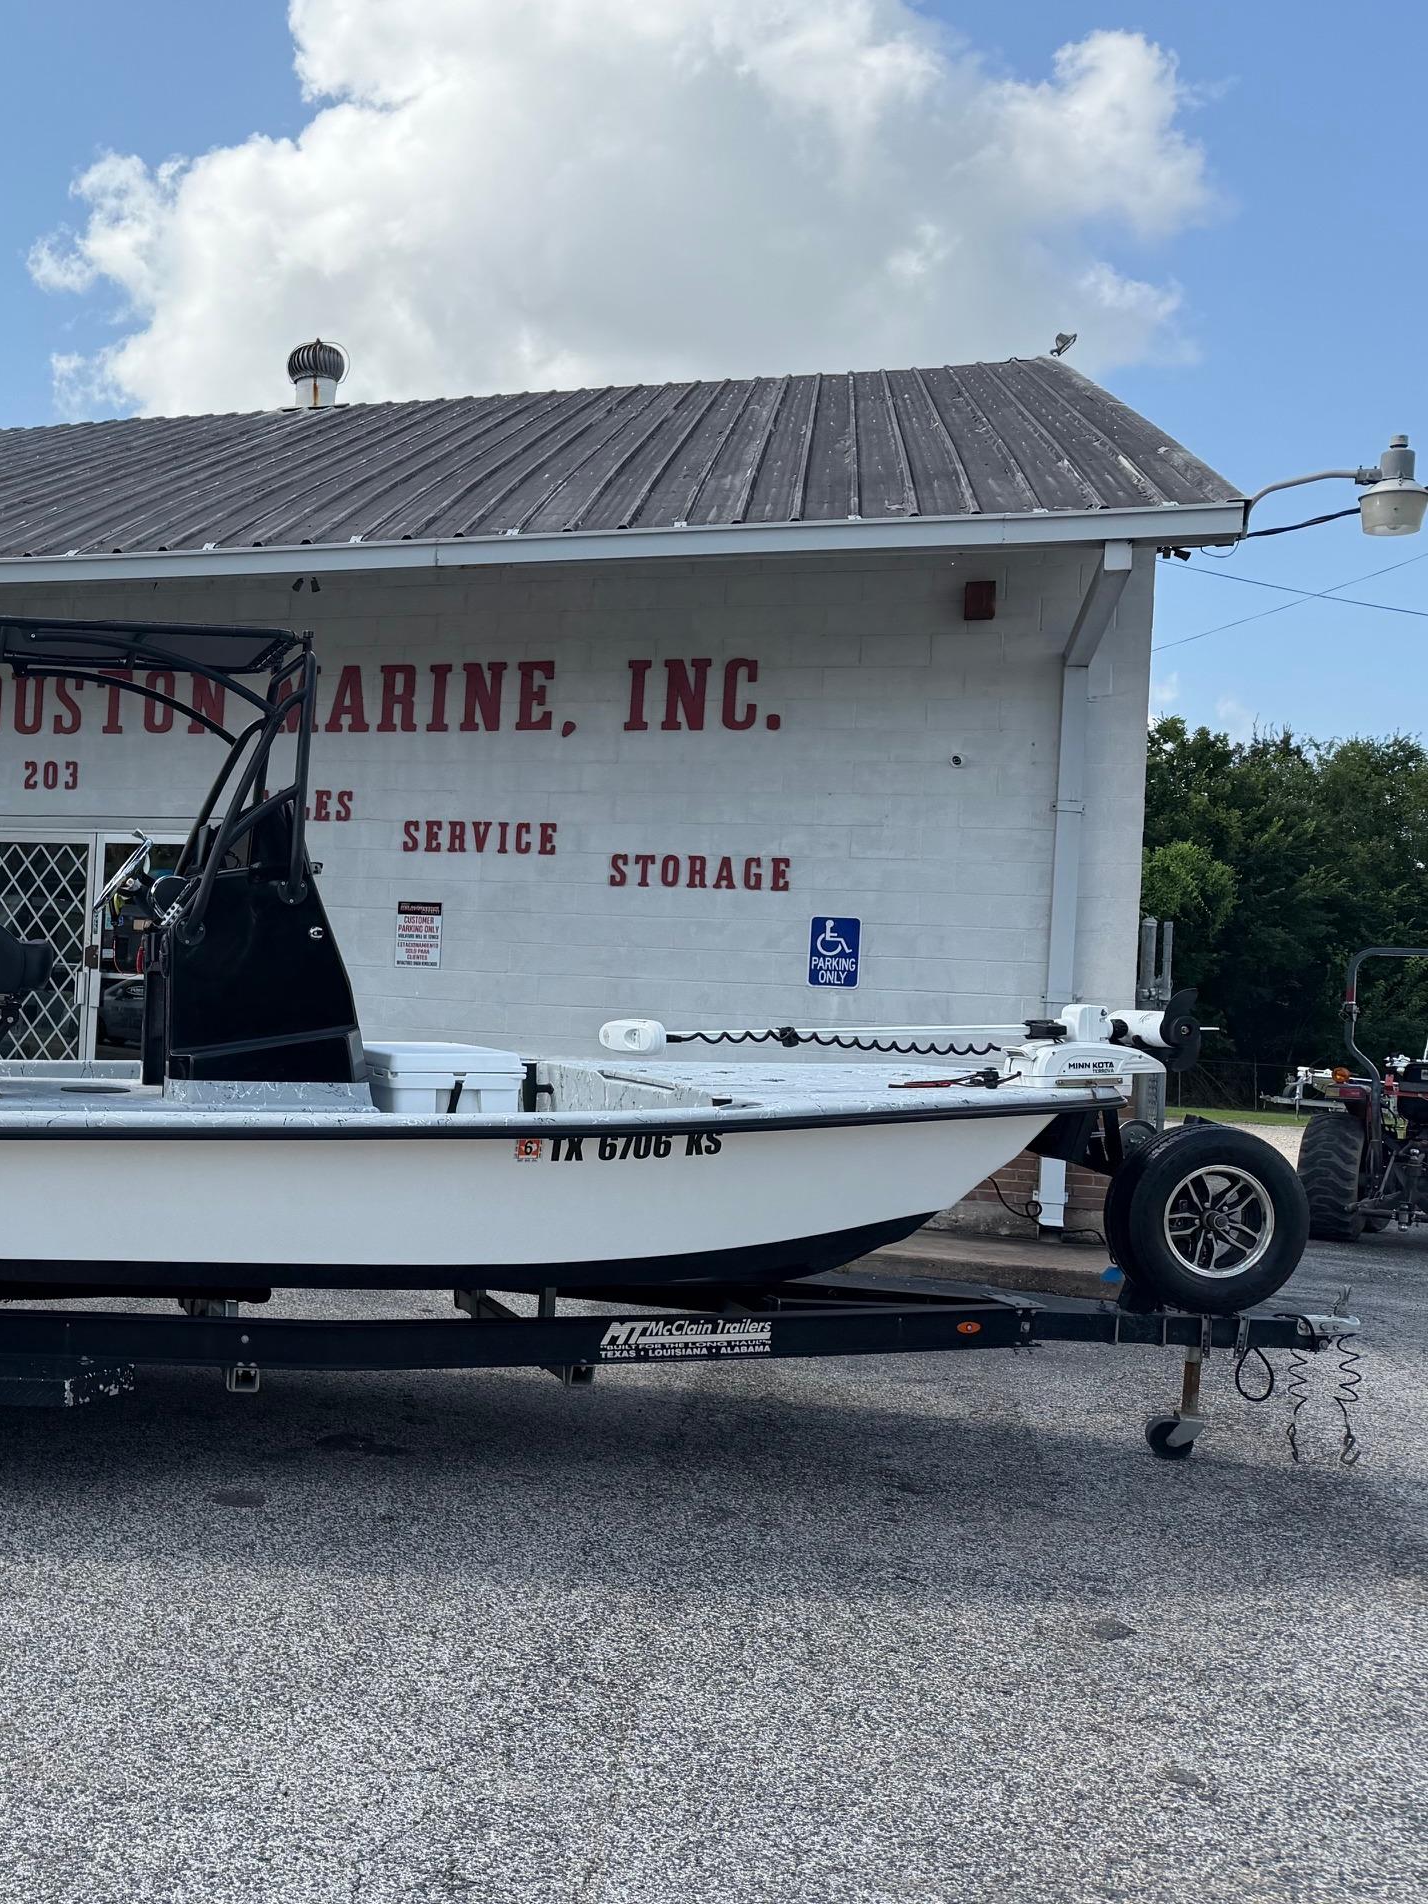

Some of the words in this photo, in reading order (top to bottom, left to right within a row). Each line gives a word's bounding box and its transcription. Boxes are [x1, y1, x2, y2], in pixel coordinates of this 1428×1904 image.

[623, 657, 782, 732] INC.
[23, 760, 80, 790] 203
[402, 820, 558, 856] SERVICE
[609, 853, 791, 892] STORAGE
[811, 956, 856, 972] PARKING
[818, 970, 848, 985] ONLY
[1068, 1062, 1091, 1070] MINN
[1092, 1061, 1115, 1069] KOTA
[523, 1139, 534, 1155] 6
[548, 1136, 584, 1162] TX
[597, 1134, 673, 1161] 6706
[684, 1132, 723, 1157] KS
[600, 1321, 651, 1346] MT
[645, 1320, 713, 1337] McClain
[716, 1318, 772, 1334] Trailers
[648, 1349, 708, 1357] LOUISIANA
[720, 1345, 771, 1354] ALABAMA
